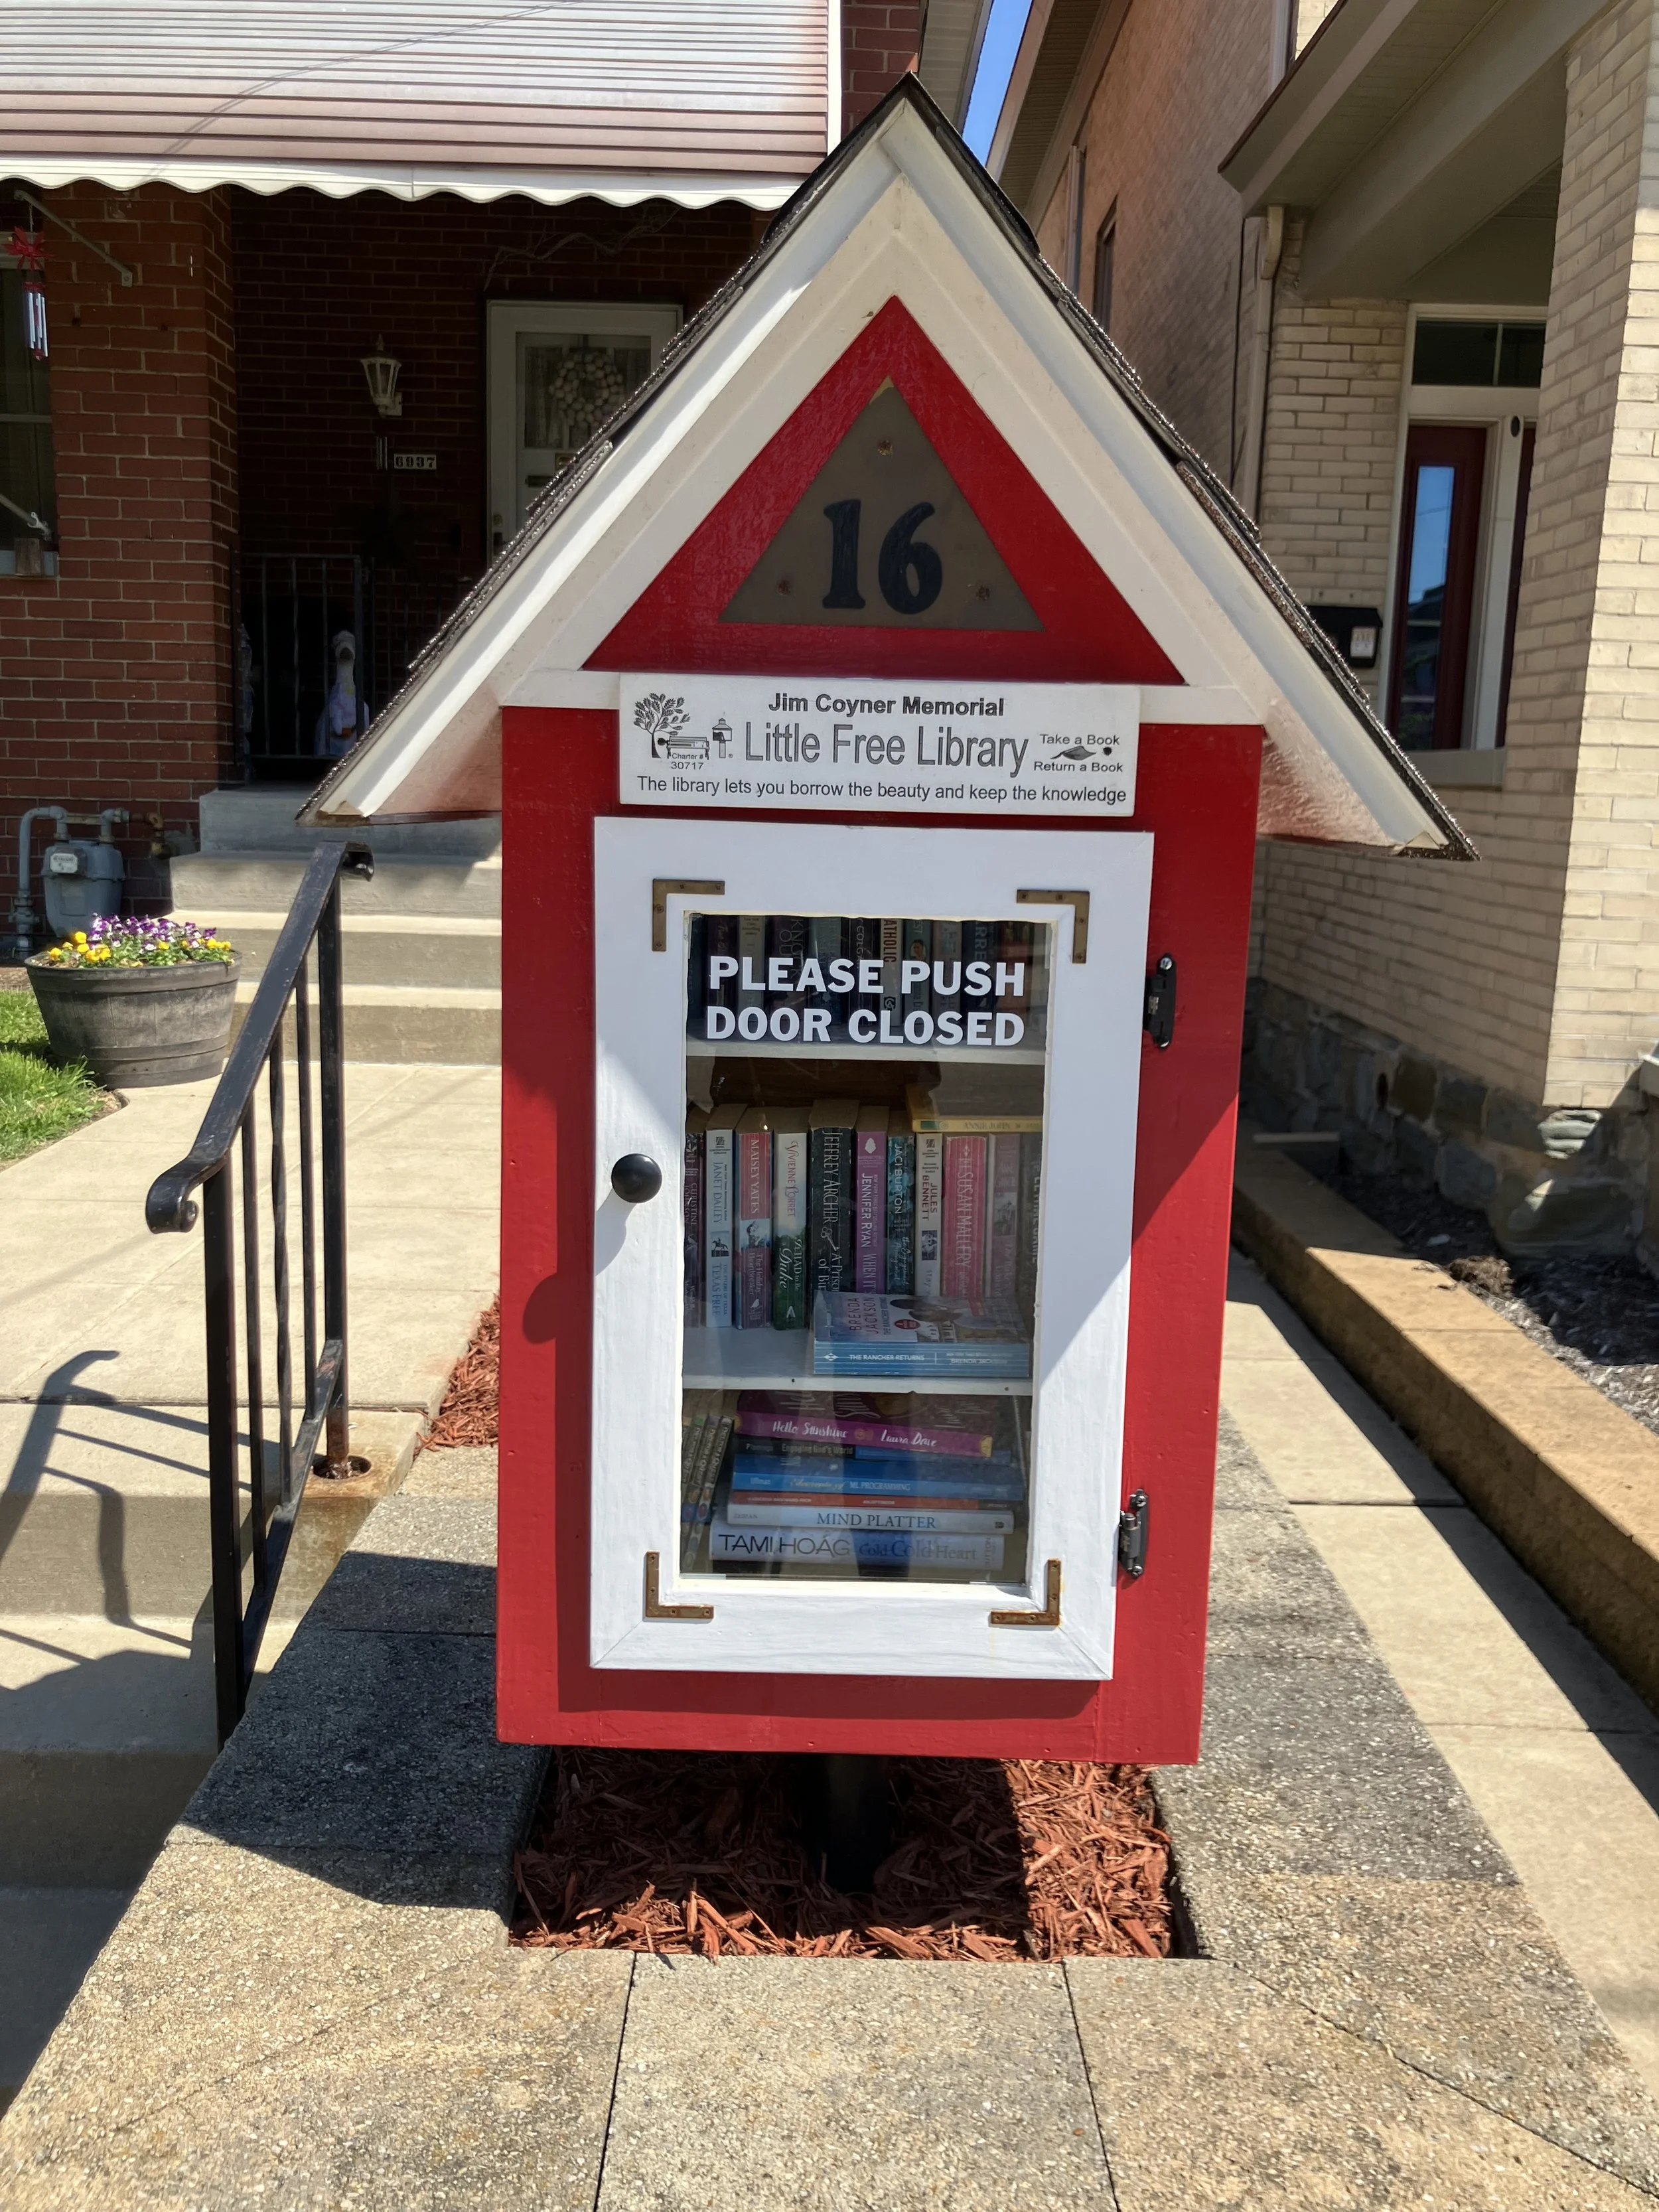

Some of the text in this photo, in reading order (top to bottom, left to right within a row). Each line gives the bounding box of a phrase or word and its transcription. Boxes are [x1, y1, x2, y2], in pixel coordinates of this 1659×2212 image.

[822, 498, 943, 615] 16
[768, 693, 1004, 717] Jim Coyner Memorial
[746, 721, 1029, 778] Little Free Library
[1040, 733, 1070, 744] Take
[1087, 734, 1120, 745] Book
[671, 761, 705, 770] 30717
[1034, 761, 1075, 771] Return
[1092, 762, 1123, 773] Book
[637, 776, 1127, 806] The library lets you borrow the beauty and keep the knowledge
[856, 925, 865, 970] COLGA
[710, 956, 884, 994] PLEASE
[901, 960, 1025, 997] PUSH
[707, 1006, 1025, 1047] DOOR CLOSED
[713, 1162, 724, 1224] JANET DAILEY
[750, 1140, 760, 1214] MAISEY YATES
[784, 1140, 800, 1217] VIVIENNE LORRET
[823, 1130, 843, 1224] JEFFREY ARCHER
[893, 1143, 903, 1214] JACI BURTON
[956, 1172, 974, 1211] SUSAN
[861, 1173, 873, 1248] JENNIFER RYAN
[922, 1175, 930, 1221] BENNETT
[930, 1183, 939, 1214] JULES
[956, 1216, 973, 1268] MALLERY
[779, 1248, 794, 1290] Duke
[794, 1253, 802, 1274] HAD
[818, 1258, 831, 1291] of Bir
[863, 1253, 877, 1278] WHEN
[712, 1264, 723, 1317] TEXAS FREE
[847, 1297, 862, 1331] BRENDA
[862, 1297, 879, 1335] JACKSON
[772, 1420, 938, 1447] Hello Sunshine Laura Dave
[817, 1512, 863, 1526] MIND
[867, 1515, 936, 1529] PLATTER
[718, 1534, 774, 1554] TAMI
[859, 1542, 887, 1557] Cold
[892, 1540, 932, 1557] Cold
[936, 1545, 977, 1560] Heart
